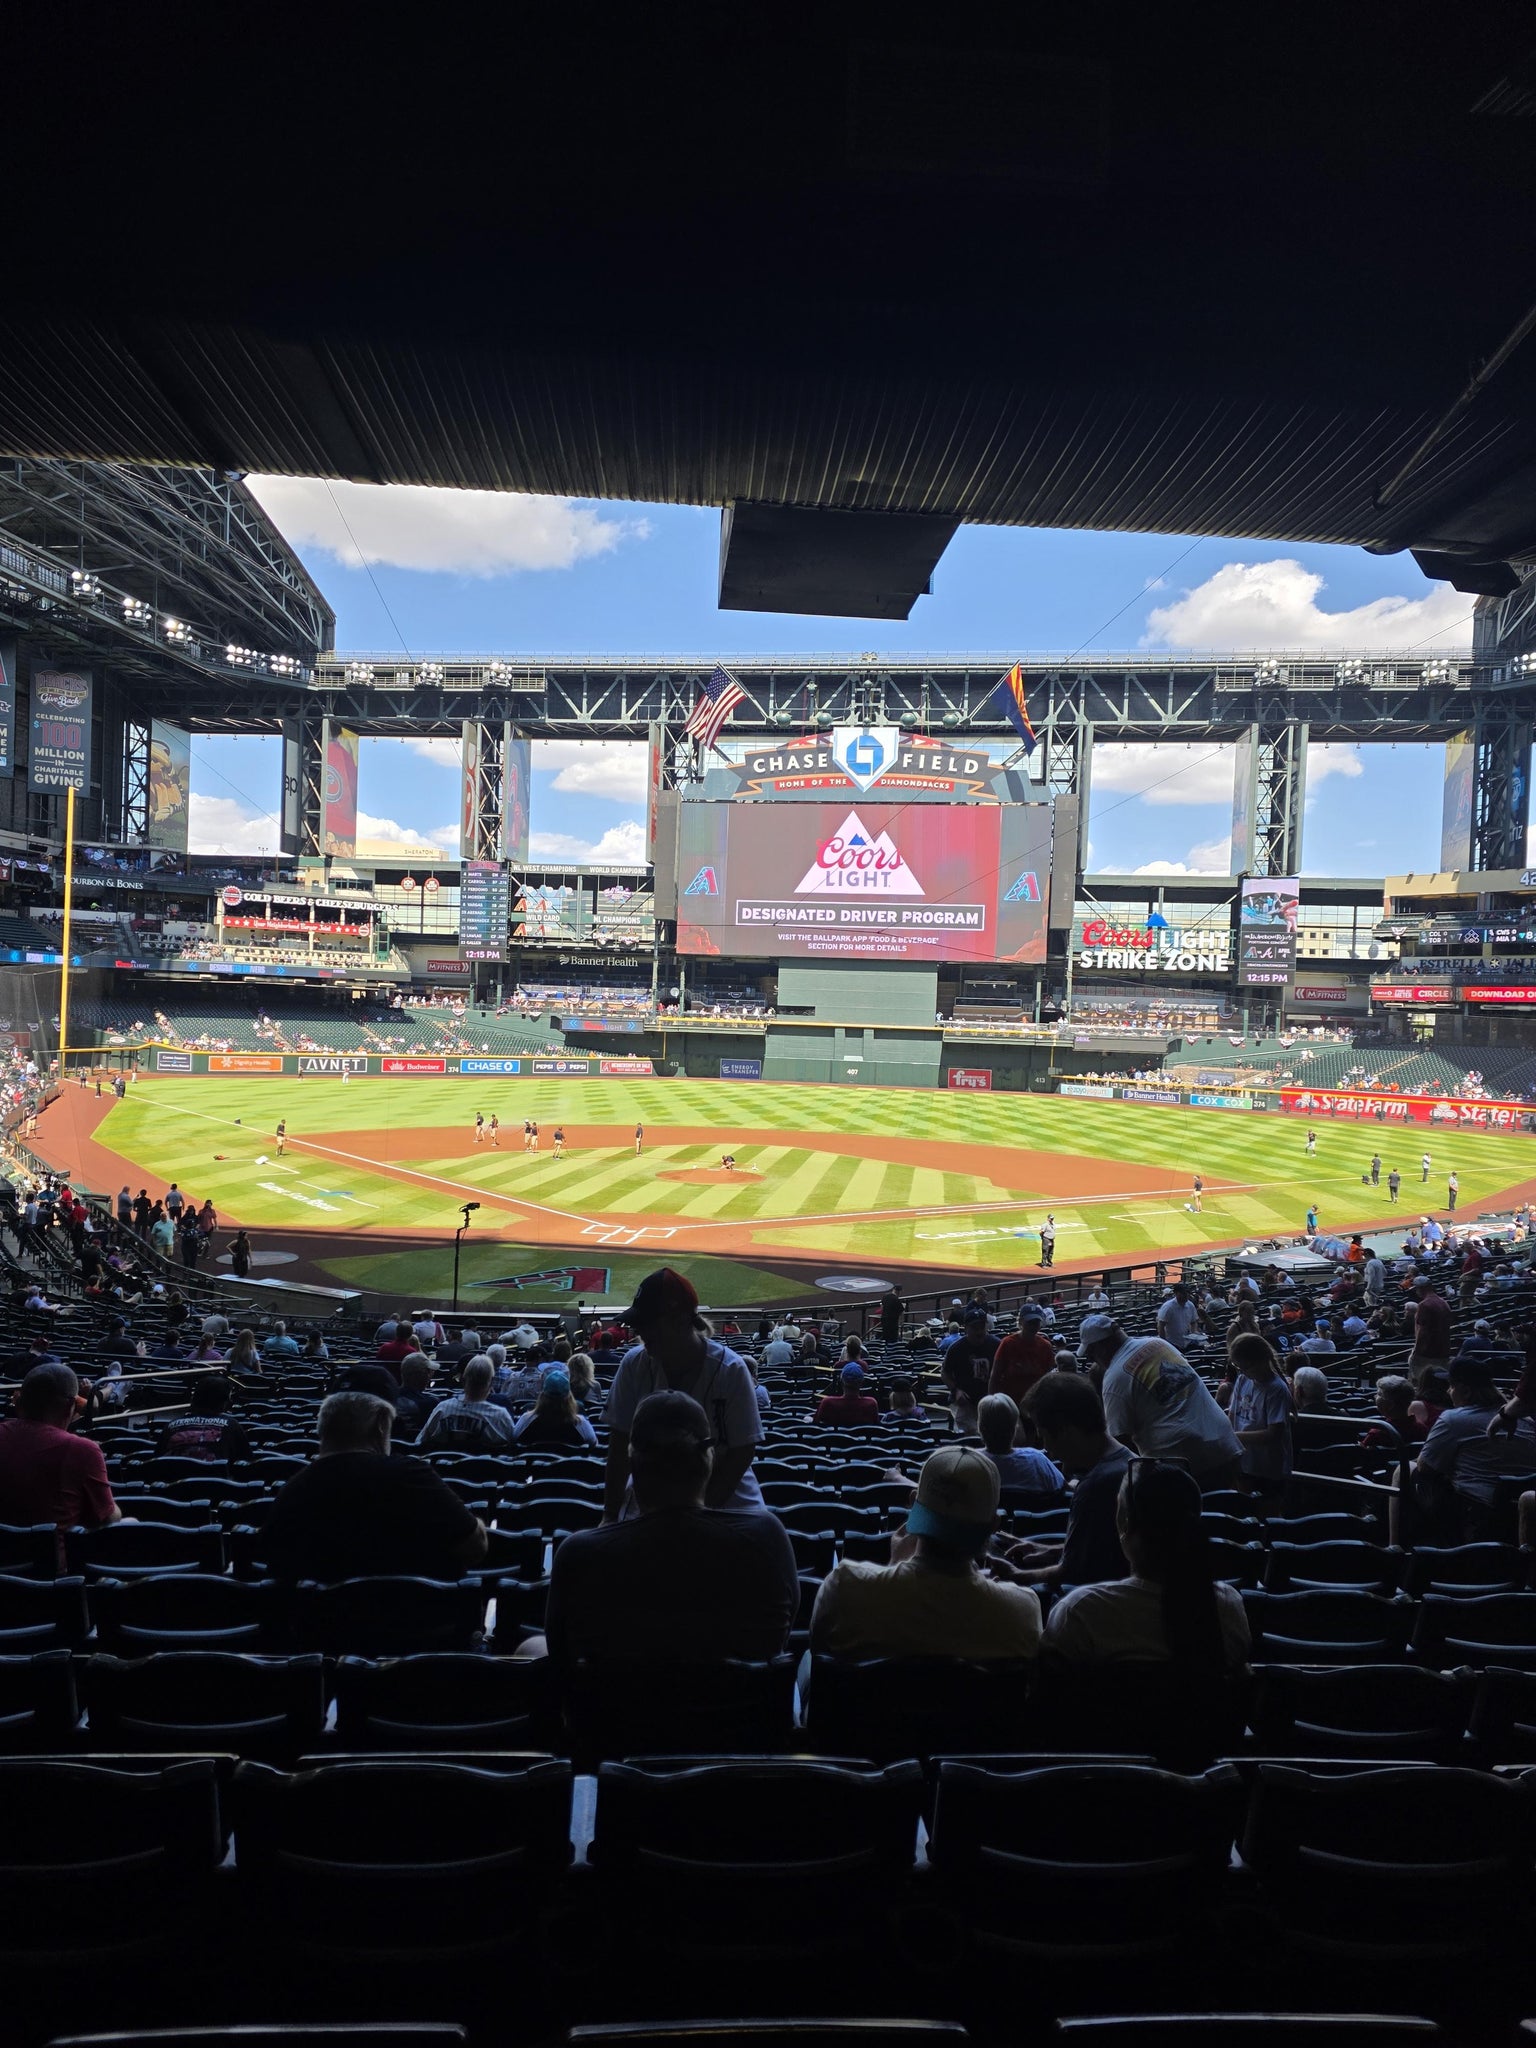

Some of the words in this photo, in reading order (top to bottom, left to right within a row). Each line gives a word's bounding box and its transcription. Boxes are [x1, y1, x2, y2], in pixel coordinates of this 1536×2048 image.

[36, 713, 85, 724] CELEBRATING
[33, 720, 81, 749] $100
[35, 747, 84, 760] MILLION
[753, 753, 828, 772] CHASE
[903, 753, 979, 774] FIELD
[34, 766, 84, 776] CHARITABLE
[34, 774, 84, 787] GIVING
[779, 780, 804, 788] HOME
[881, 779, 950, 789] DIAMONDBACKS
[816, 837, 903, 870] Coors
[64, 875, 104, 886] OURBON
[106, 878, 115, 887] &
[826, 871, 891, 887] LIGHT
[244, 892, 271, 902] COLD
[273, 895, 306, 905] BEERS
[307, 898, 314, 906] &
[316, 899, 400, 911] CHEESEBURGERS
[603, 916, 640, 924] CHAMPIONS
[742, 908, 836, 922] DESIGNATED
[840, 909, 896, 923] DRIVER
[902, 910, 978, 924] PROGRAM
[1082, 919, 1154, 948] Coors
[1160, 930, 1229, 949] LIGHT
[1526, 931, 1533, 939] 8
[877, 944, 907, 952] DETAILS
[571, 956, 606, 966] Banner
[608, 957, 638, 967] Health
[1080, 950, 1158, 969] STRIKE
[1163, 952, 1229, 972] ZONE
[1419, 959, 1486, 968] ESTRELLA
[1247, 974, 1270, 982] 12:15
[1272, 974, 1288, 982] PM
[1418, 990, 1449, 998] CIRCLE
[1471, 990, 1524, 998] DOWNLOAD
[306, 1058, 361, 1070] AVNET
[468, 1062, 502, 1070] CHASE
[952, 1070, 986, 1087] fry's
[1134, 1092, 1155, 1100] Banner
[1156, 1093, 1176, 1101] Health
[1198, 1096, 1217, 1105] COX
[1224, 1098, 1244, 1108] COX
[1254, 1100, 1266, 1108] 374
[1321, 1095, 1364, 1112] State
[1365, 1099, 1408, 1115] Farm
[1460, 1105, 1510, 1122] State
